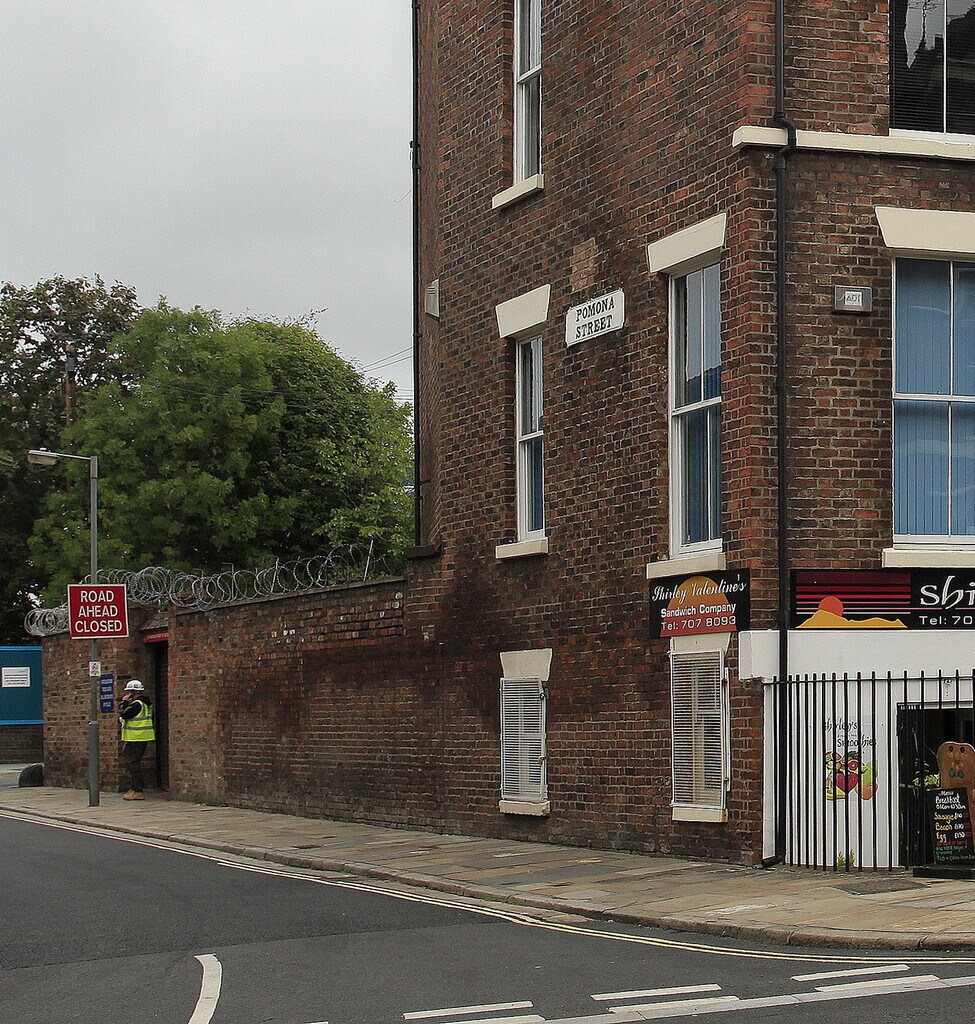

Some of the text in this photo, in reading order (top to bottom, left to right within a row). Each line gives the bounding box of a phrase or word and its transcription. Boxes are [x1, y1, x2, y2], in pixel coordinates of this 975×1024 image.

[576, 296, 615, 322] POMONA
[575, 314, 613, 339] STREET
[652, 574, 747, 604] Shirley Valentine's
[80, 590, 115, 603] ROAD
[78, 605, 119, 618] AHEAD
[660, 603, 737, 618] Sandwich Company
[75, 619, 123, 633] CLOSED
[661, 615, 736, 631] Tel: 707 8093
[919, 615, 947, 625] Tel:
[936, 832, 947, 843] Egg
